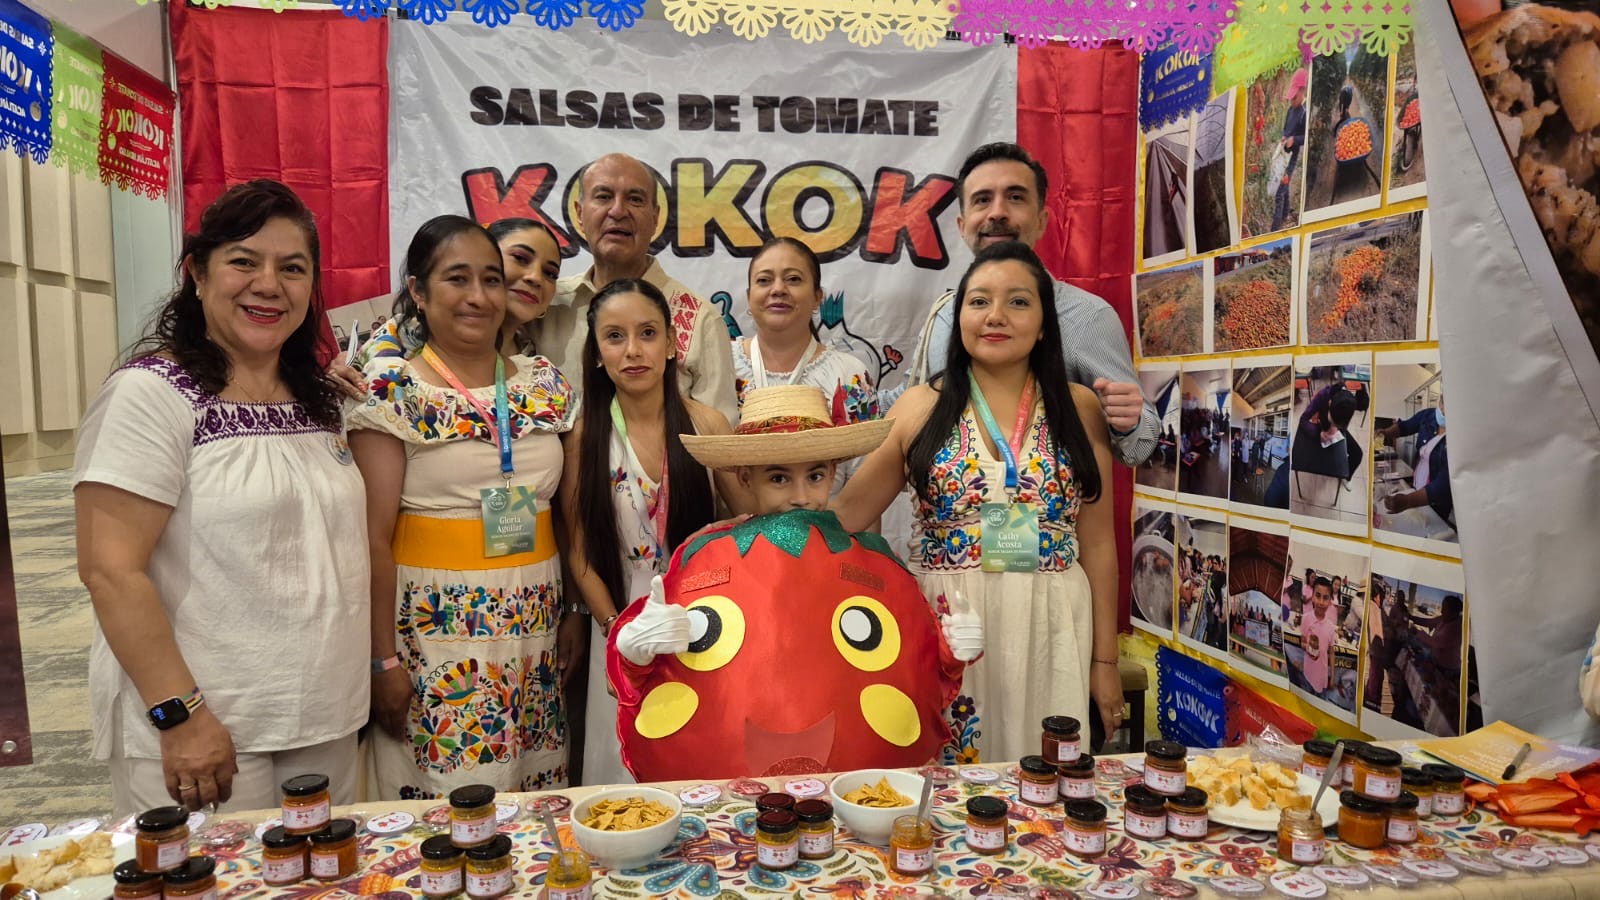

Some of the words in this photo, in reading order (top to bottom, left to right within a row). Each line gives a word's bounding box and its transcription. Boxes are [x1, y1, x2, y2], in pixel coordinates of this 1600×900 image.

[469, 85, 664, 132] SALSAS
[678, 94, 742, 133] DE
[753, 95, 940, 137] TOMATE
